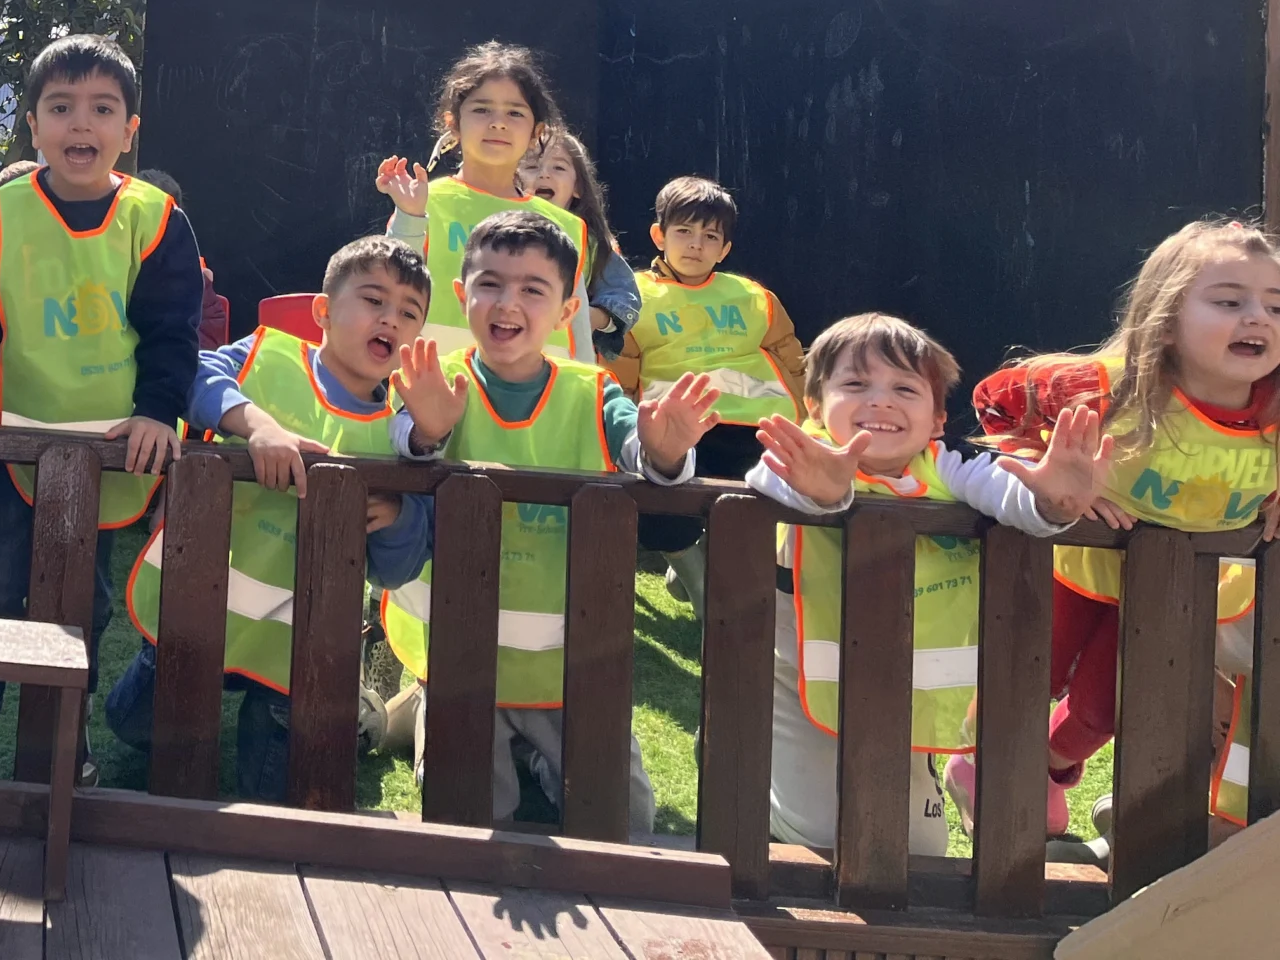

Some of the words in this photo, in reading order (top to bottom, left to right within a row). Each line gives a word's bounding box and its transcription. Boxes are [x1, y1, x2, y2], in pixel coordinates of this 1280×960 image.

[656, 303, 747, 336] NOVA
[1130, 467, 1269, 521] NOV
[926, 582, 944, 593] 601
[945, 578, 959, 590] 73
[960, 575, 972, 585] 71
